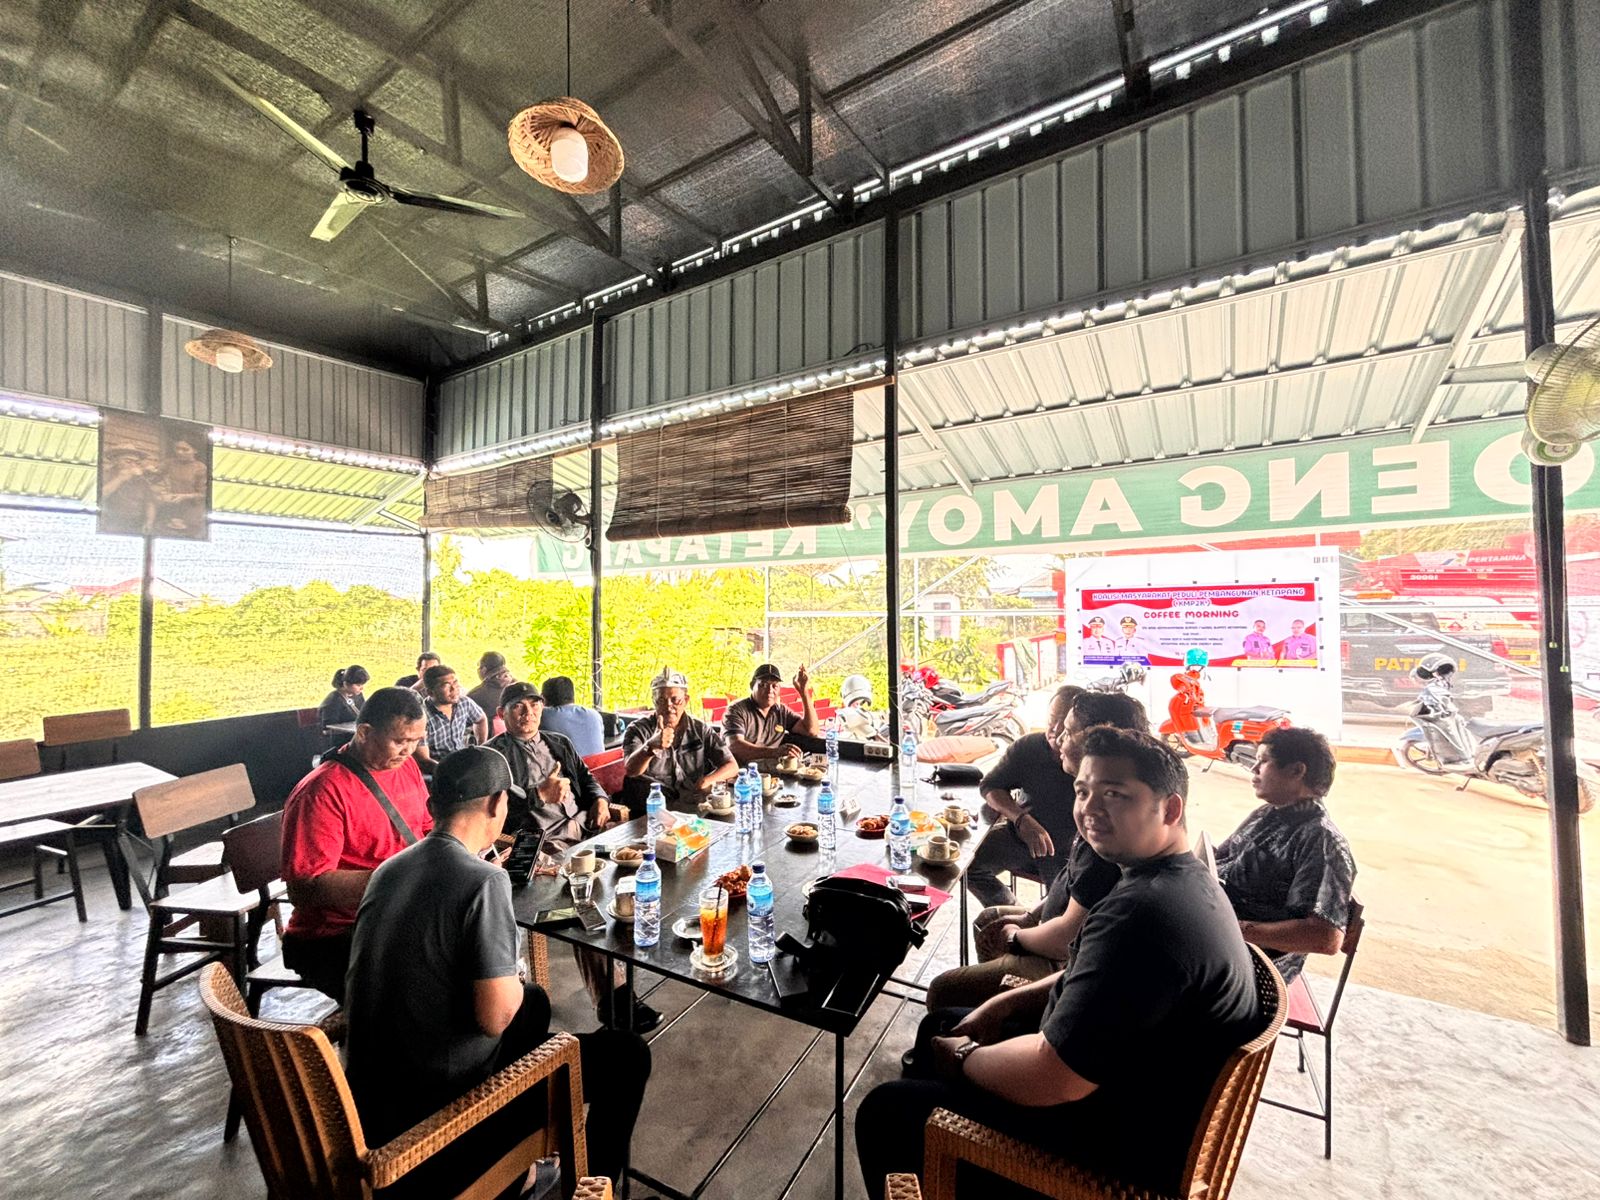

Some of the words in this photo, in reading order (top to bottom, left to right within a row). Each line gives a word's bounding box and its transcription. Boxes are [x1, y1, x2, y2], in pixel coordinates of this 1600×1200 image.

[1467, 554, 1527, 563] PERTAMINA
[1121, 591, 1170, 600] MASYARAKAT
[1200, 589, 1258, 597] PEMBANGUNAN
[1261, 587, 1304, 596] KETAPANG
[1144, 611, 1180, 619] COFFEE
[1185, 609, 1239, 619] MORNING
